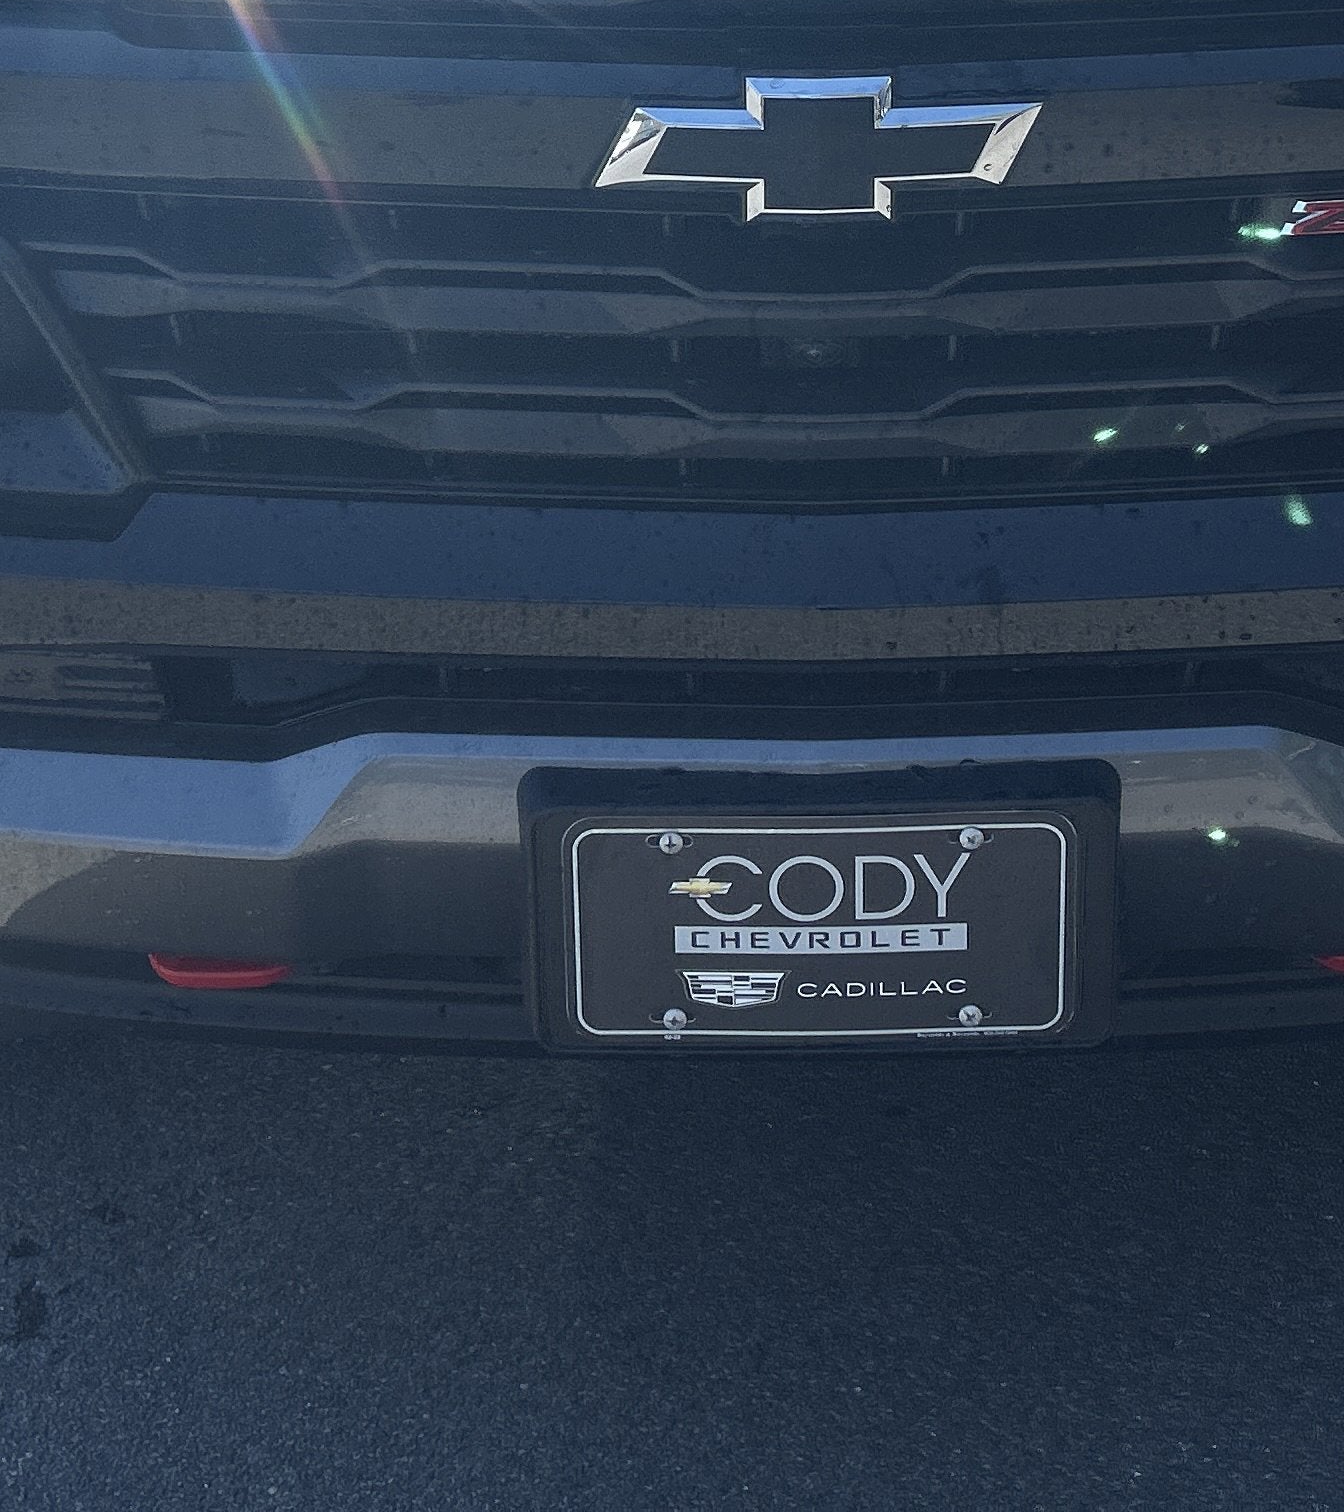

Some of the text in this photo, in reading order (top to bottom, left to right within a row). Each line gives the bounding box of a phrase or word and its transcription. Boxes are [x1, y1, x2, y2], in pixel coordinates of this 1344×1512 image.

[696, 852, 971, 922] CODY
[690, 928, 952, 949] CHEVROLET
[796, 978, 967, 998] CADILLAC
